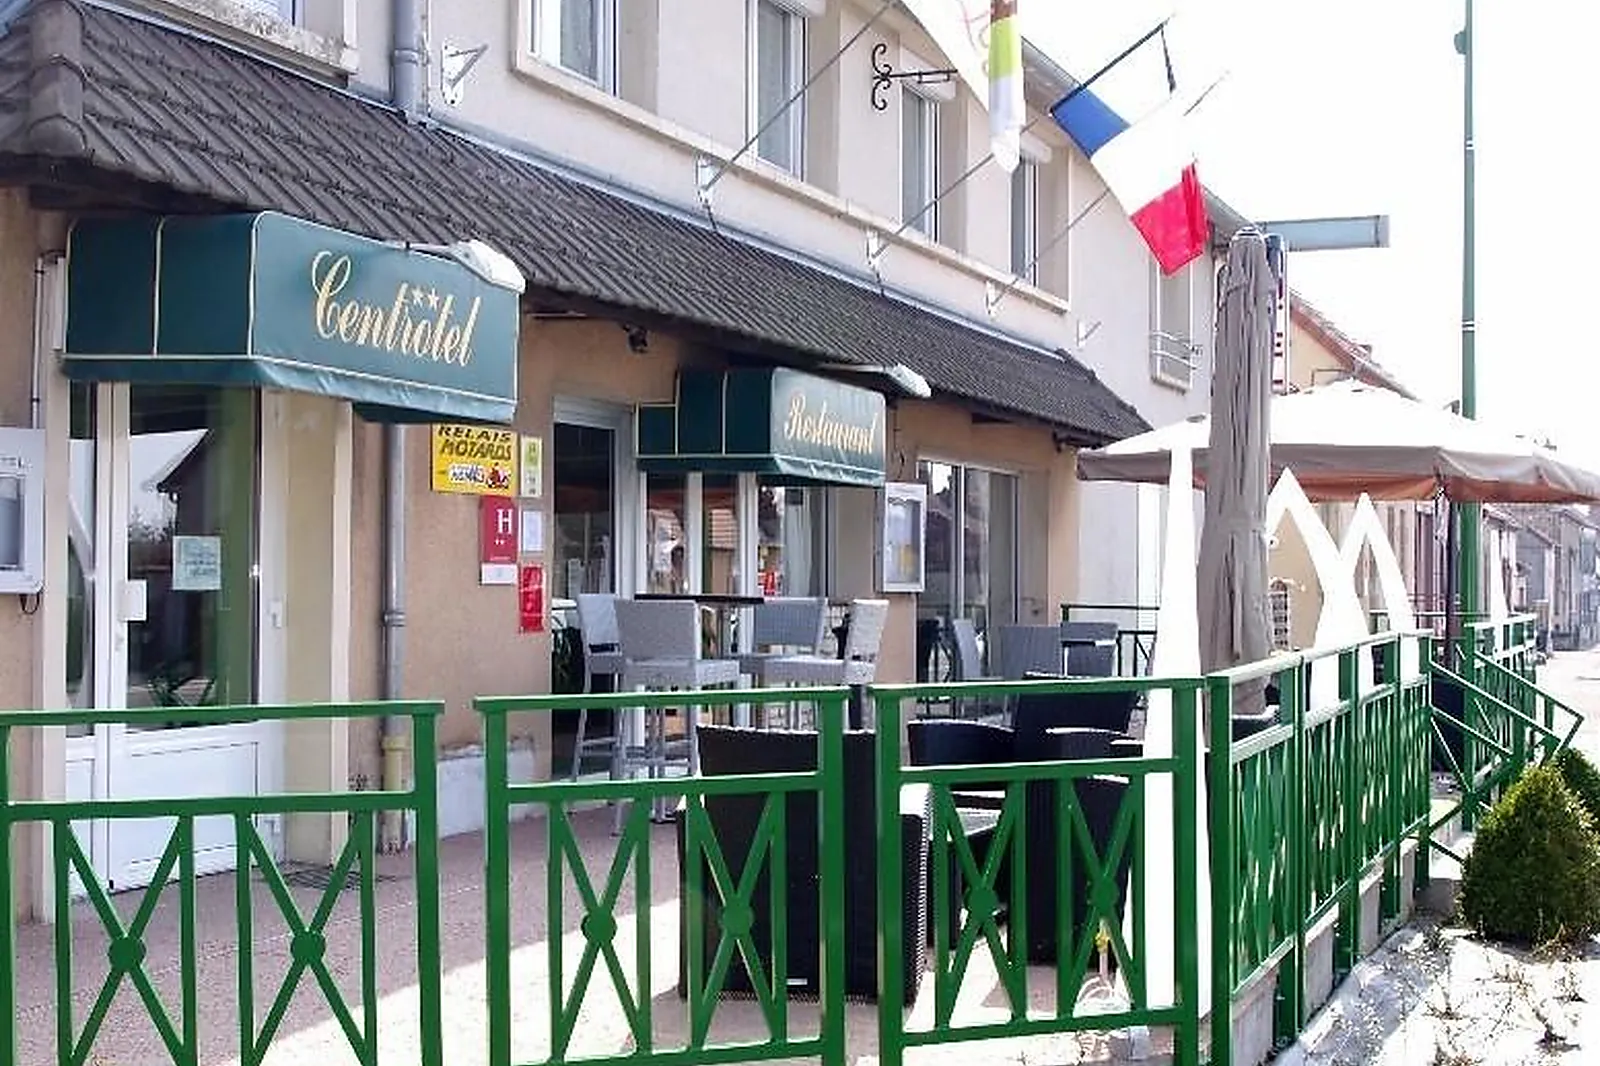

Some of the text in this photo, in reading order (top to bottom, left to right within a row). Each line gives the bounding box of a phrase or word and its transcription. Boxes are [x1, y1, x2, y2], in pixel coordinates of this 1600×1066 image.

[311, 251, 481, 367] Centrotel
[438, 425, 512, 442] RELAIS
[783, 394, 879, 456] Restaurant
[439, 438, 512, 461] MOTARDS
[495, 508, 514, 535] H
